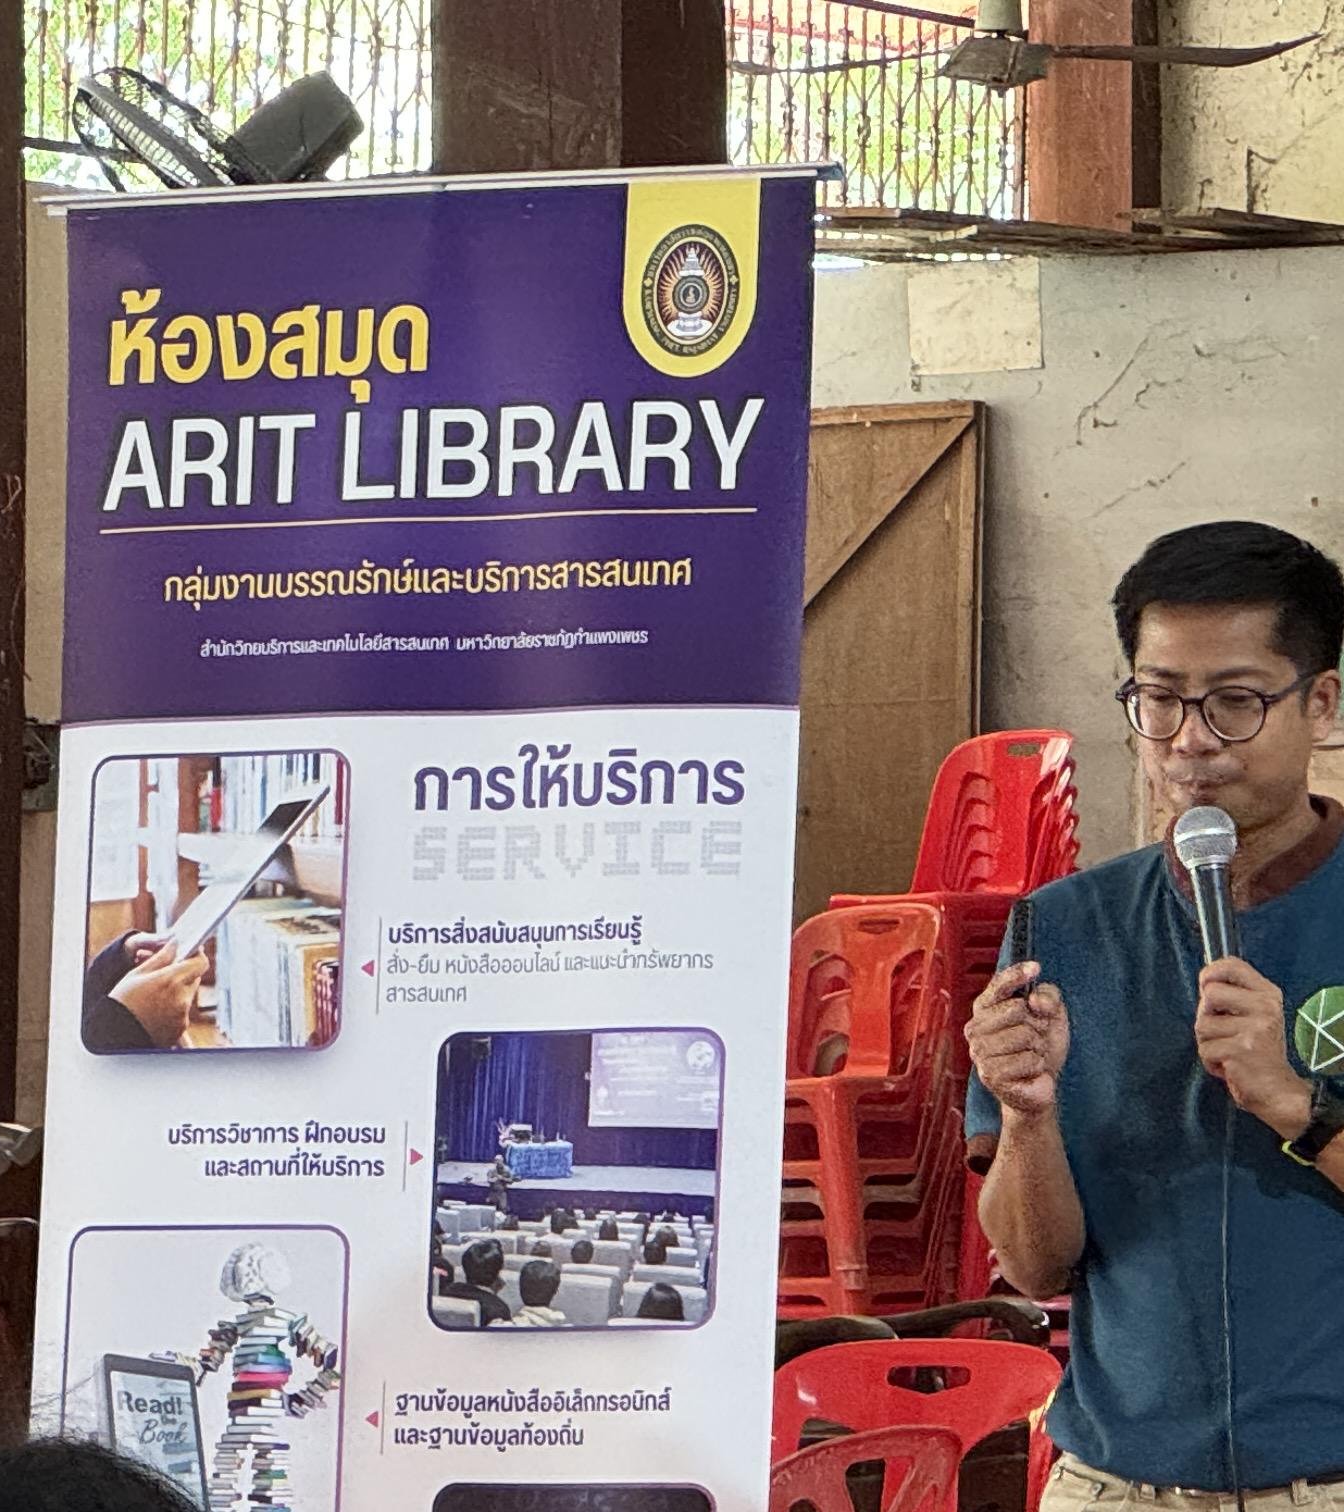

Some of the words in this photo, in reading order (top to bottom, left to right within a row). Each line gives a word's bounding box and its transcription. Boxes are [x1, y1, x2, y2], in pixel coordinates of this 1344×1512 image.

[108, 288, 429, 404] ห้องสมุด
[103, 413, 316, 512] ARIT
[342, 398, 765, 503] LIBRARY
[164, 557, 692, 611] กลุ่มงานบรรณรักษ์และบริการสารสนเทศ
[413, 744, 746, 811] การให้บริการ
[412, 820, 744, 881] SERVICE
[388, 915, 643, 948] บริการสิ่งสนับสนุนการเรียนรู้
[386, 985, 468, 1003] สารสนเทศ
[168, 1123, 300, 1145] บริการวิชาการ
[305, 1119, 386, 1144] ฝึกอบรม
[204, 1147, 385, 1177] และสถานที่ให้บริการ
[394, 1386, 672, 1419] ฐานข้อมูลหนังสืออิเล็กทรอนิกส์
[394, 1419, 585, 1453] และฐานข้อมูลท้องถิ่น
